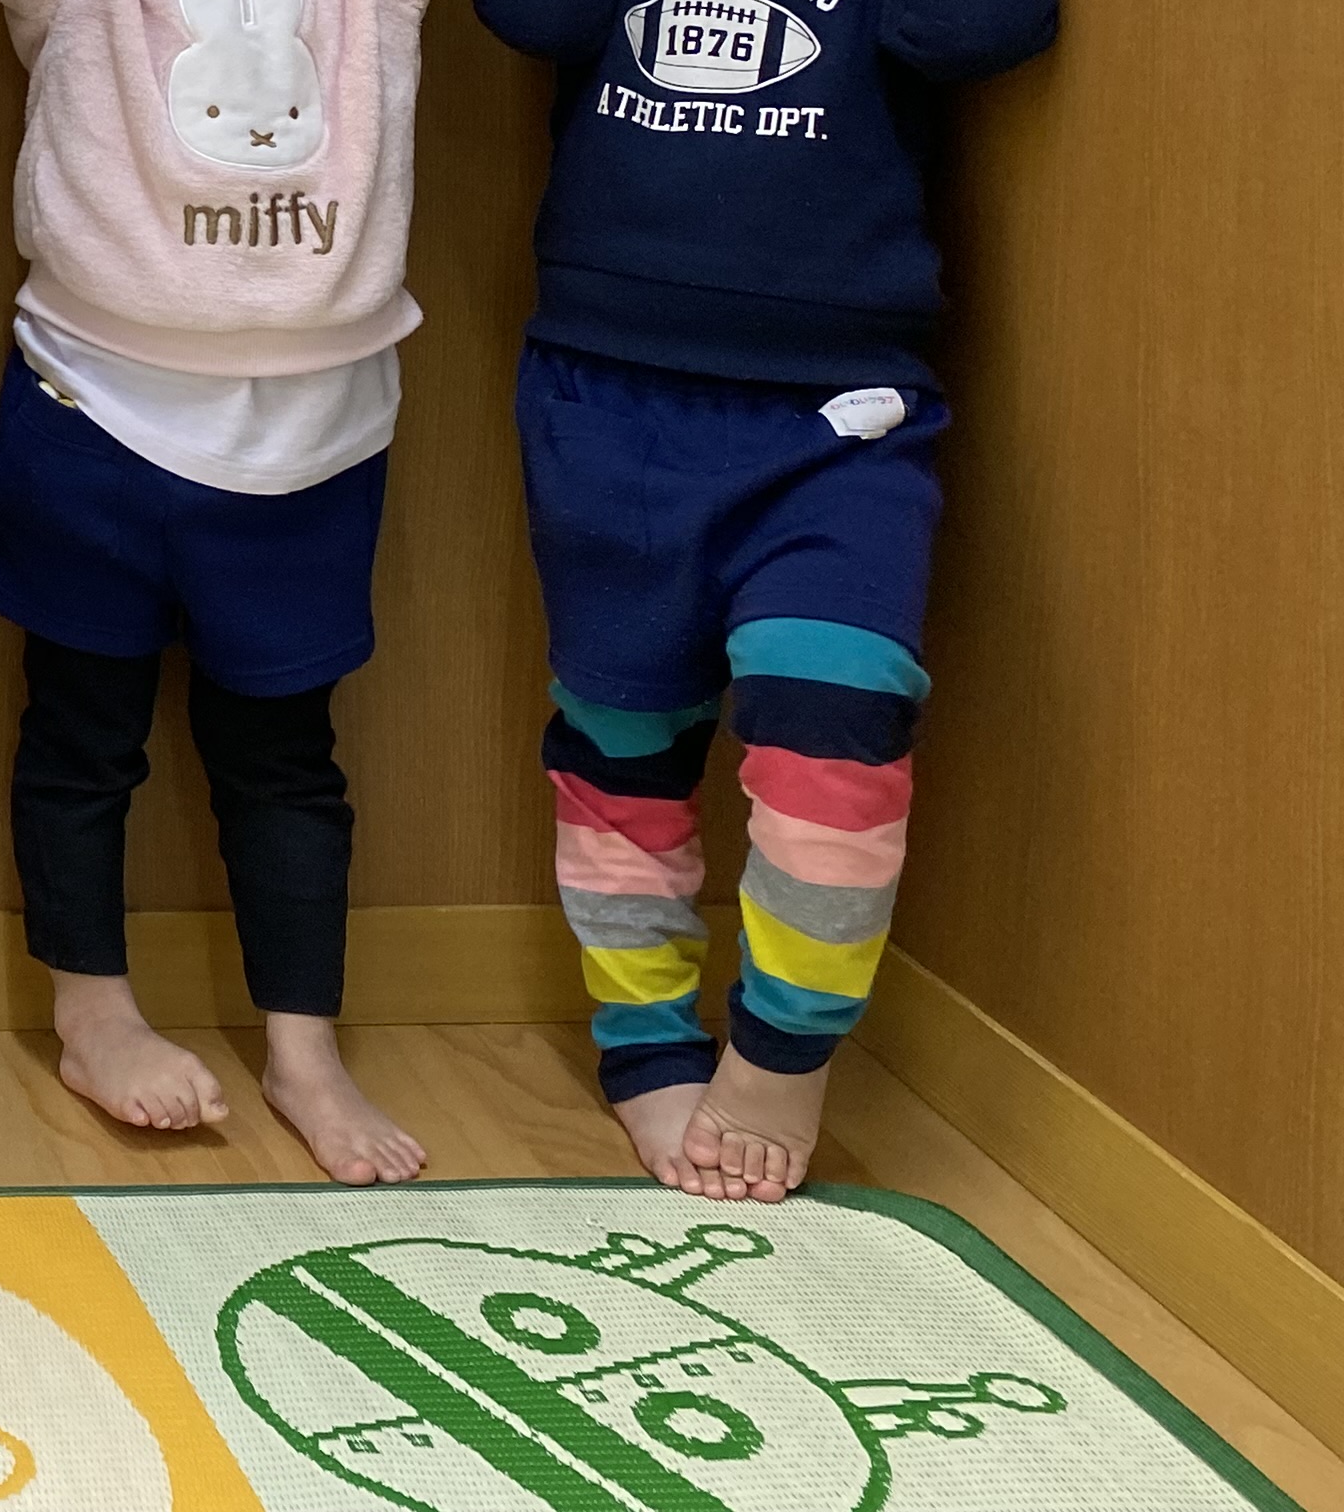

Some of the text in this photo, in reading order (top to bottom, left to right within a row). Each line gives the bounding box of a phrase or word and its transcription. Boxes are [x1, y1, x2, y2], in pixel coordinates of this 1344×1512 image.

[665, 24, 755, 62] 1876
[596, 82, 828, 140] ATHLETIC DPT.
[183, 191, 339, 255] miffy
